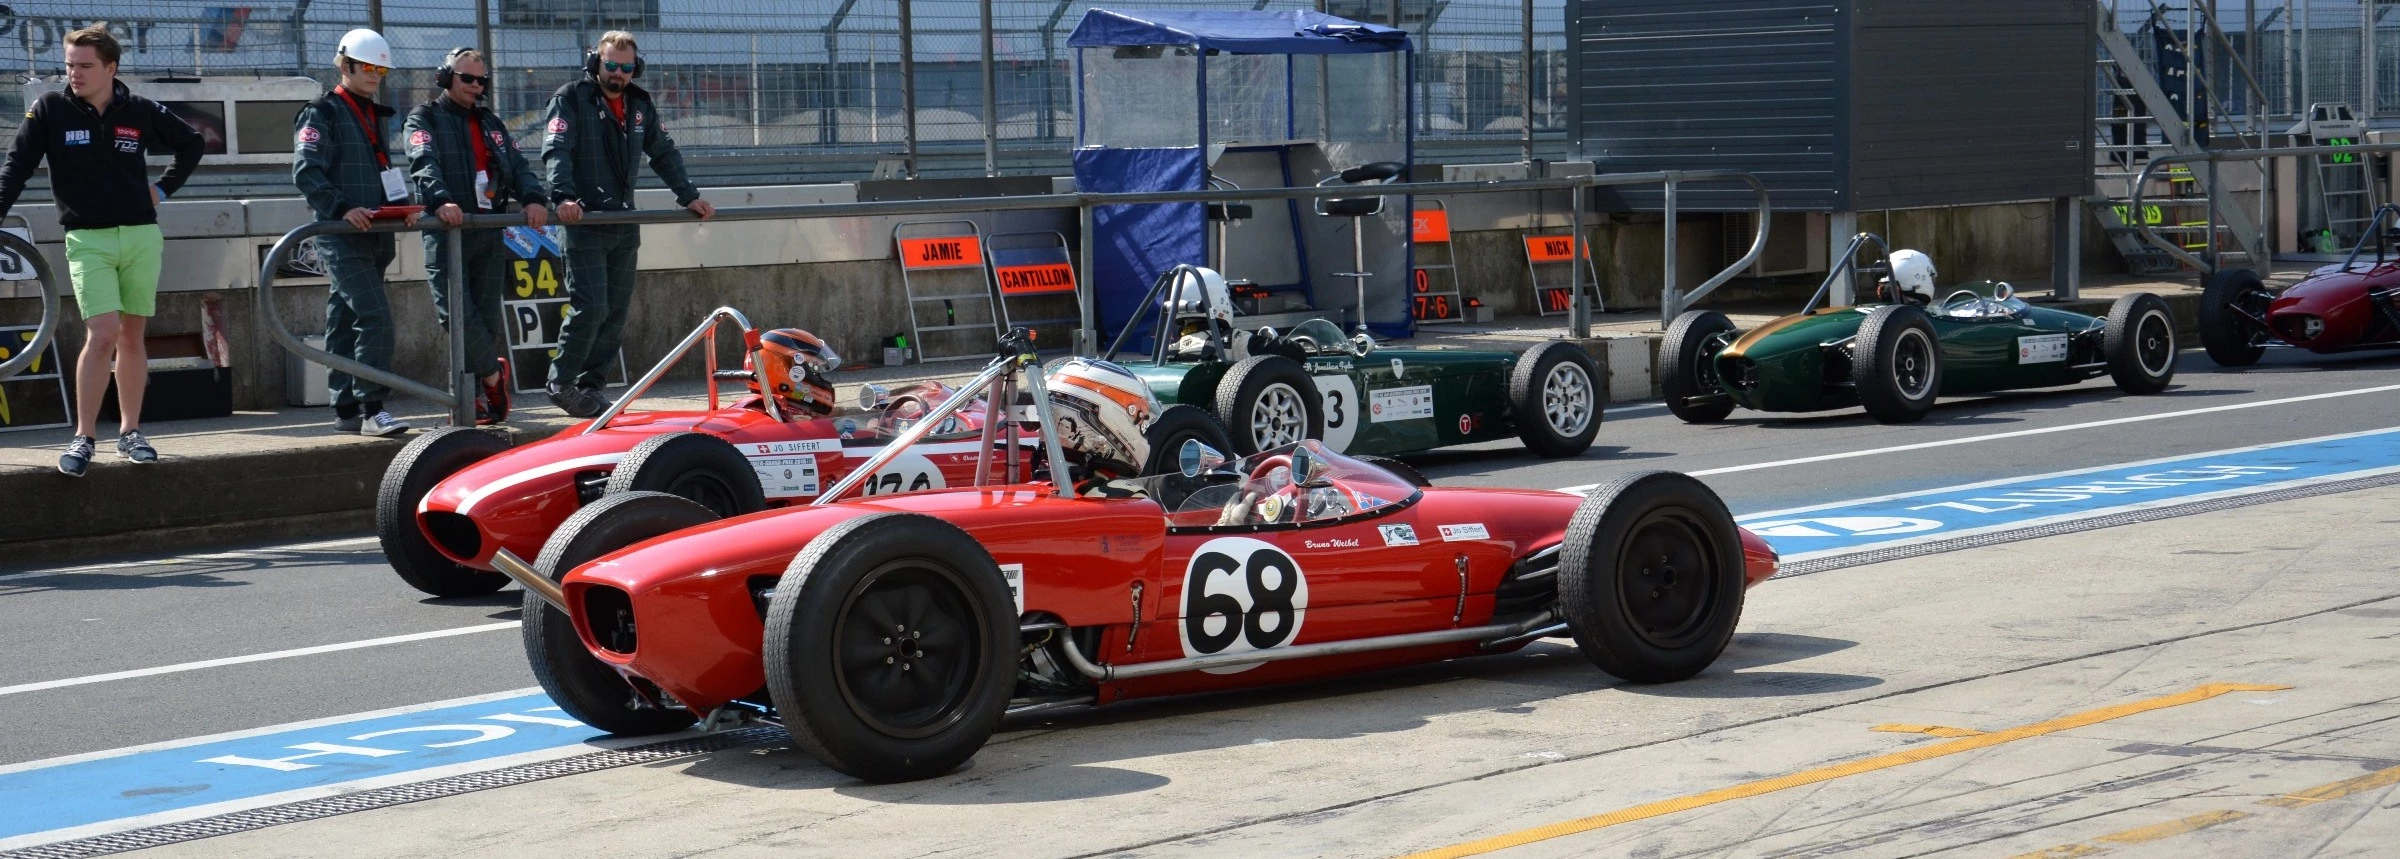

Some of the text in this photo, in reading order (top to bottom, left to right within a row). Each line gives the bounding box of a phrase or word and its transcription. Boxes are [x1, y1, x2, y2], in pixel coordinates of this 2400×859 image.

[66, 130, 90, 141] HBI
[922, 243, 963, 261] JAMIE
[1545, 241, 1571, 256] NICK
[514, 260, 558, 297] 54
[1002, 269, 1071, 288] CANTILLON
[1550, 290, 1570, 311] IN
[518, 307, 538, 343] P
[1314, 362, 1339, 373] Jonathan
[1320, 389, 1344, 428] 3
[774, 442, 820, 452] JO SIFFERT
[1909, 464, 2296, 513] ZURICH
[1305, 539, 1359, 548] Bruno Weibel
[1186, 549, 1298, 654] 68
